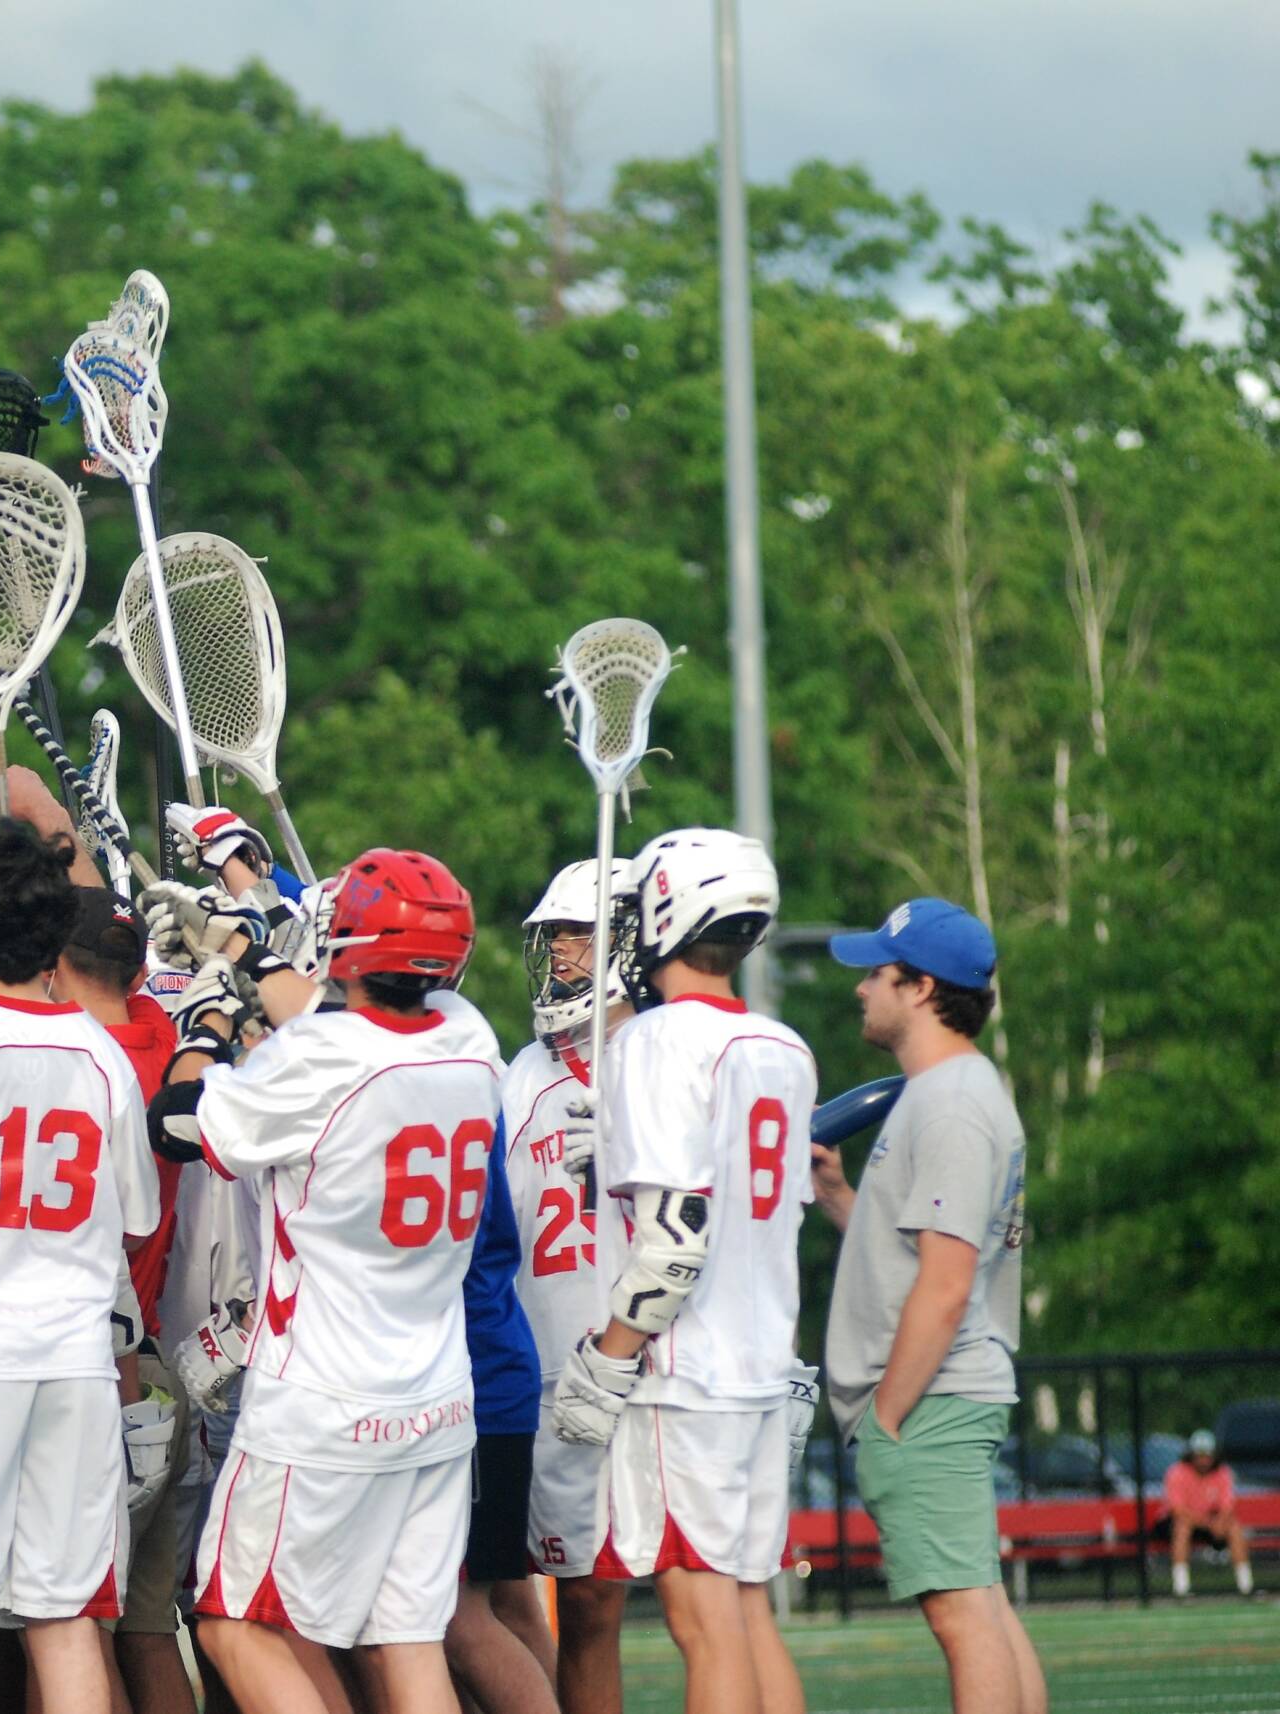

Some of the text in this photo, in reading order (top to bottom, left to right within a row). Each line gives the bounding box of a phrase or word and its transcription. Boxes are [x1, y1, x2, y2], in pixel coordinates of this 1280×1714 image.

[656, 869, 670, 896] 8
[379, 1117, 495, 1249] 66
[748, 1097, 789, 1221] 8
[539, 1536, 567, 1565] 15
